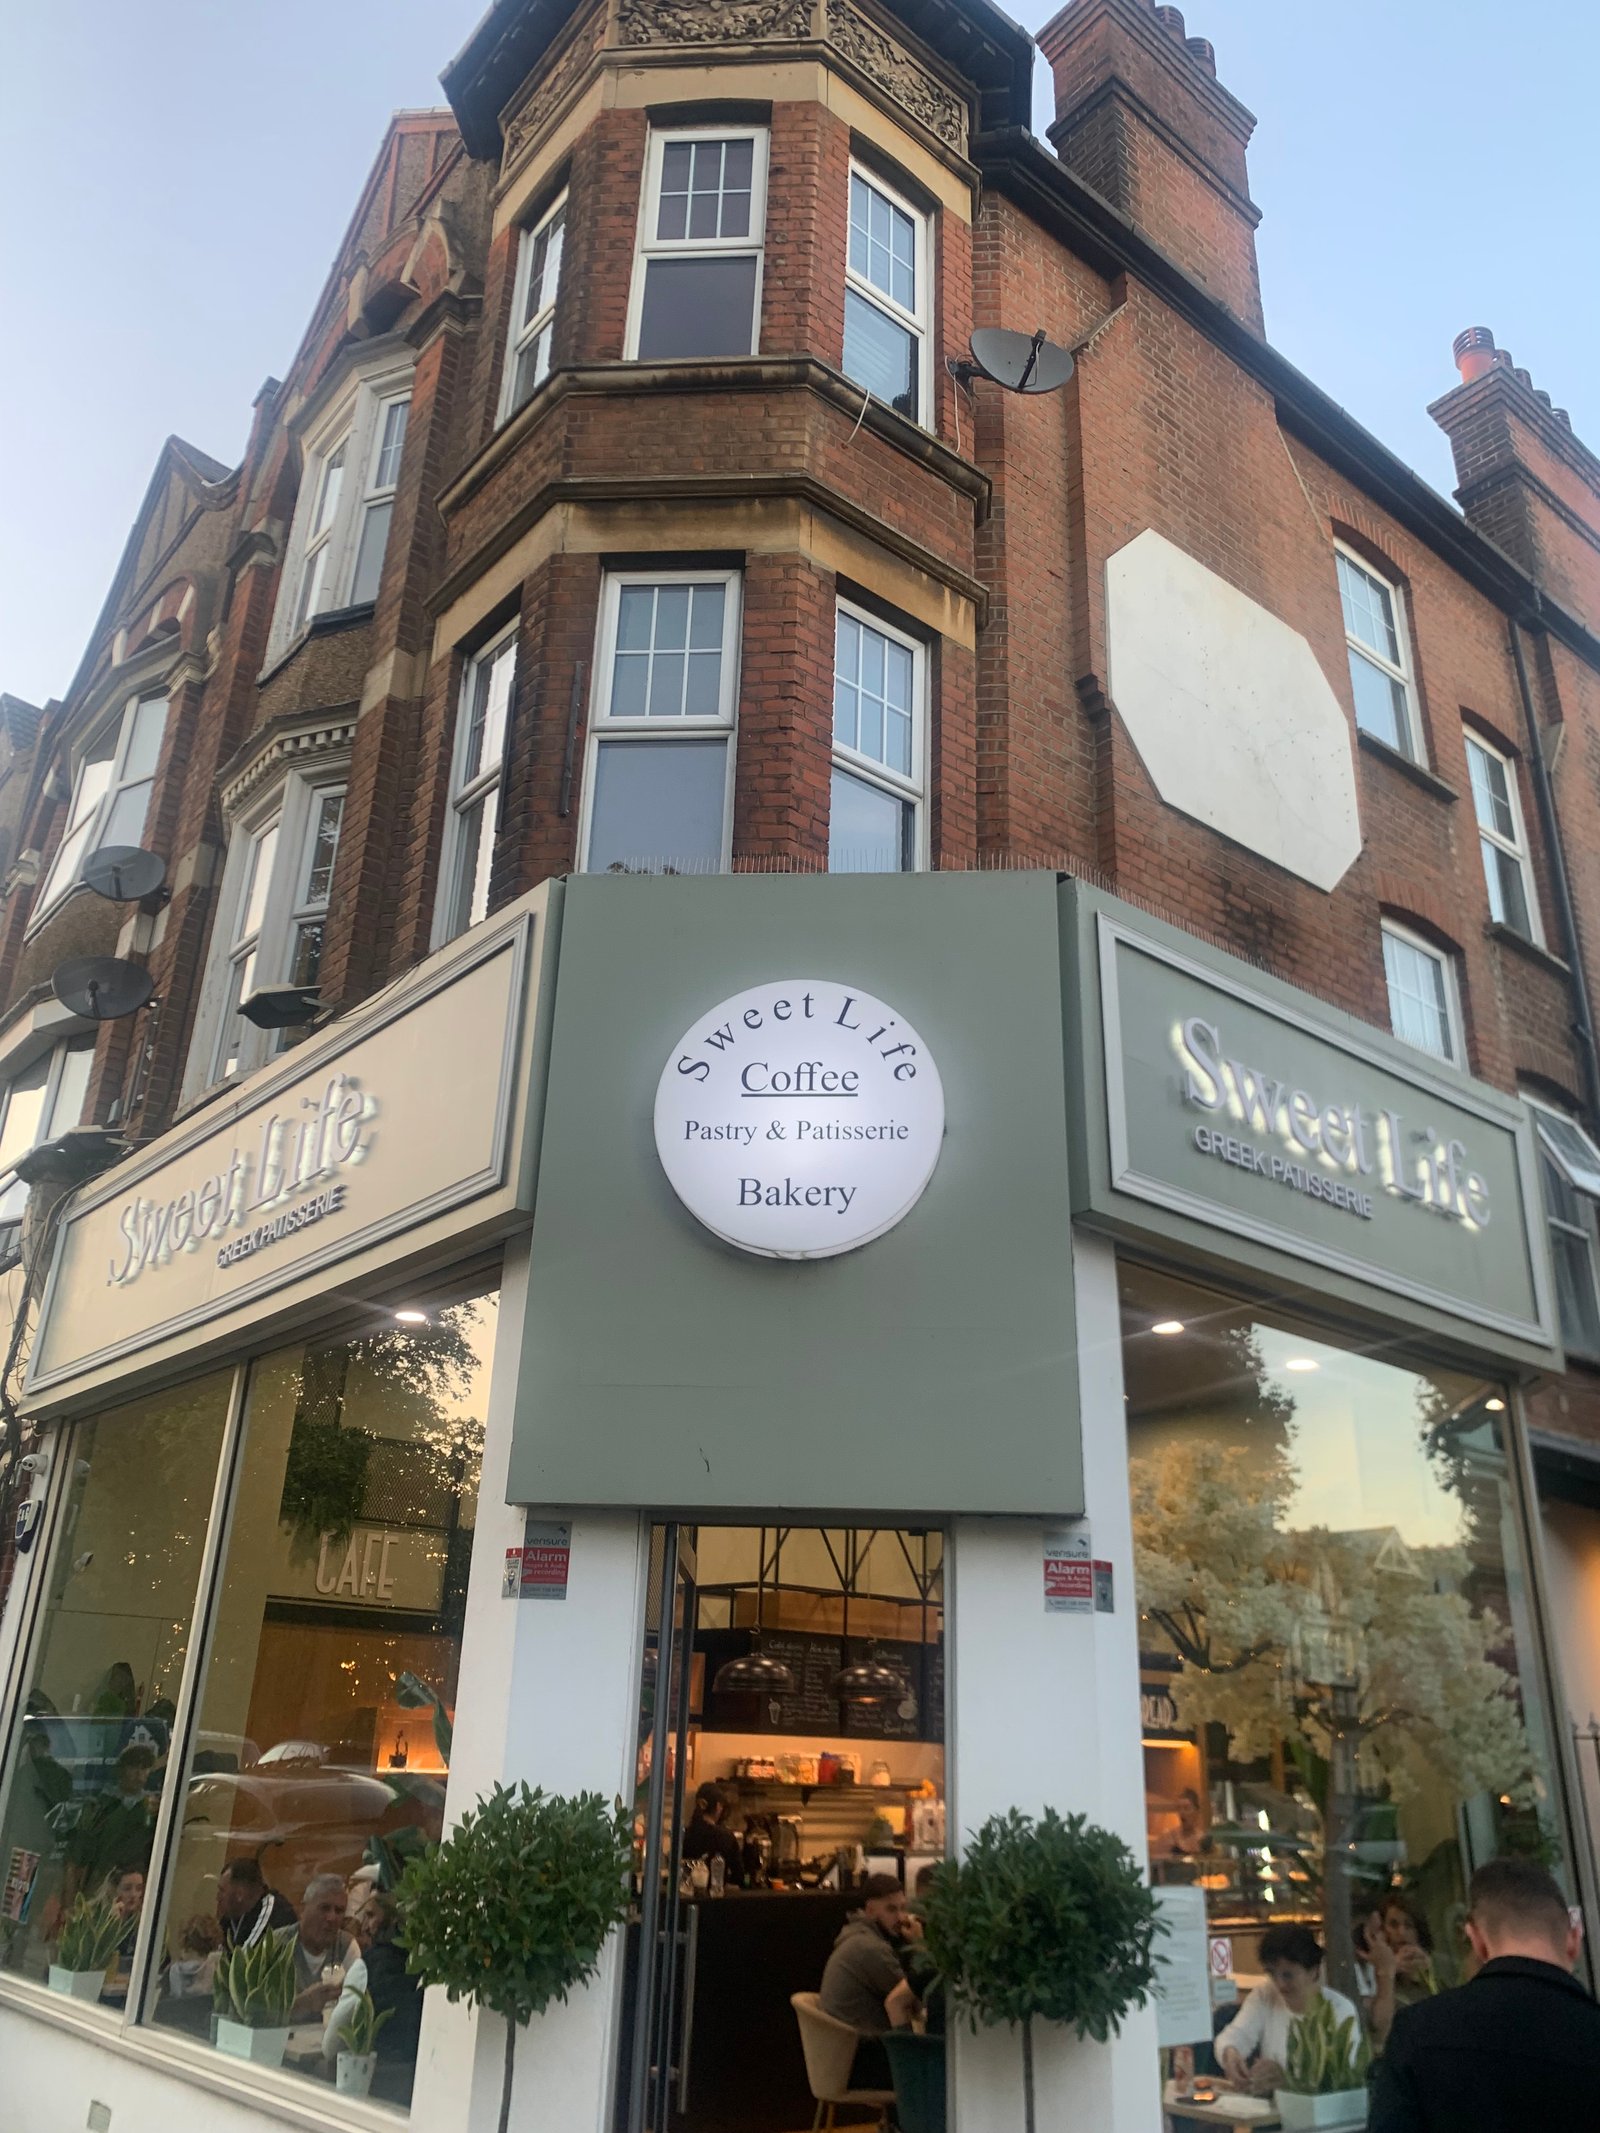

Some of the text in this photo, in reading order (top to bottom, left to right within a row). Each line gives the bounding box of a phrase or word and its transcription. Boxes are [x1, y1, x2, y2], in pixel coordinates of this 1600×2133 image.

[677, 992, 917, 1083] Sweet Life
[741, 1061, 859, 1093] Coffee
[683, 1119, 910, 1146] Pastry & Patisserie
[1181, 1017, 1491, 1228] Sweet Life
[107, 1072, 365, 1287] Sweet Life
[736, 1177, 858, 1215] Bakery
[1194, 1125, 1374, 1220] GREEK PATISSERIE
[216, 1184, 347, 1269] GREEK PATISSERIE
[315, 1528, 400, 1600] CAFE
[525, 1549, 567, 1562] Alarm
[1047, 1562, 1090, 1574] Alarm
